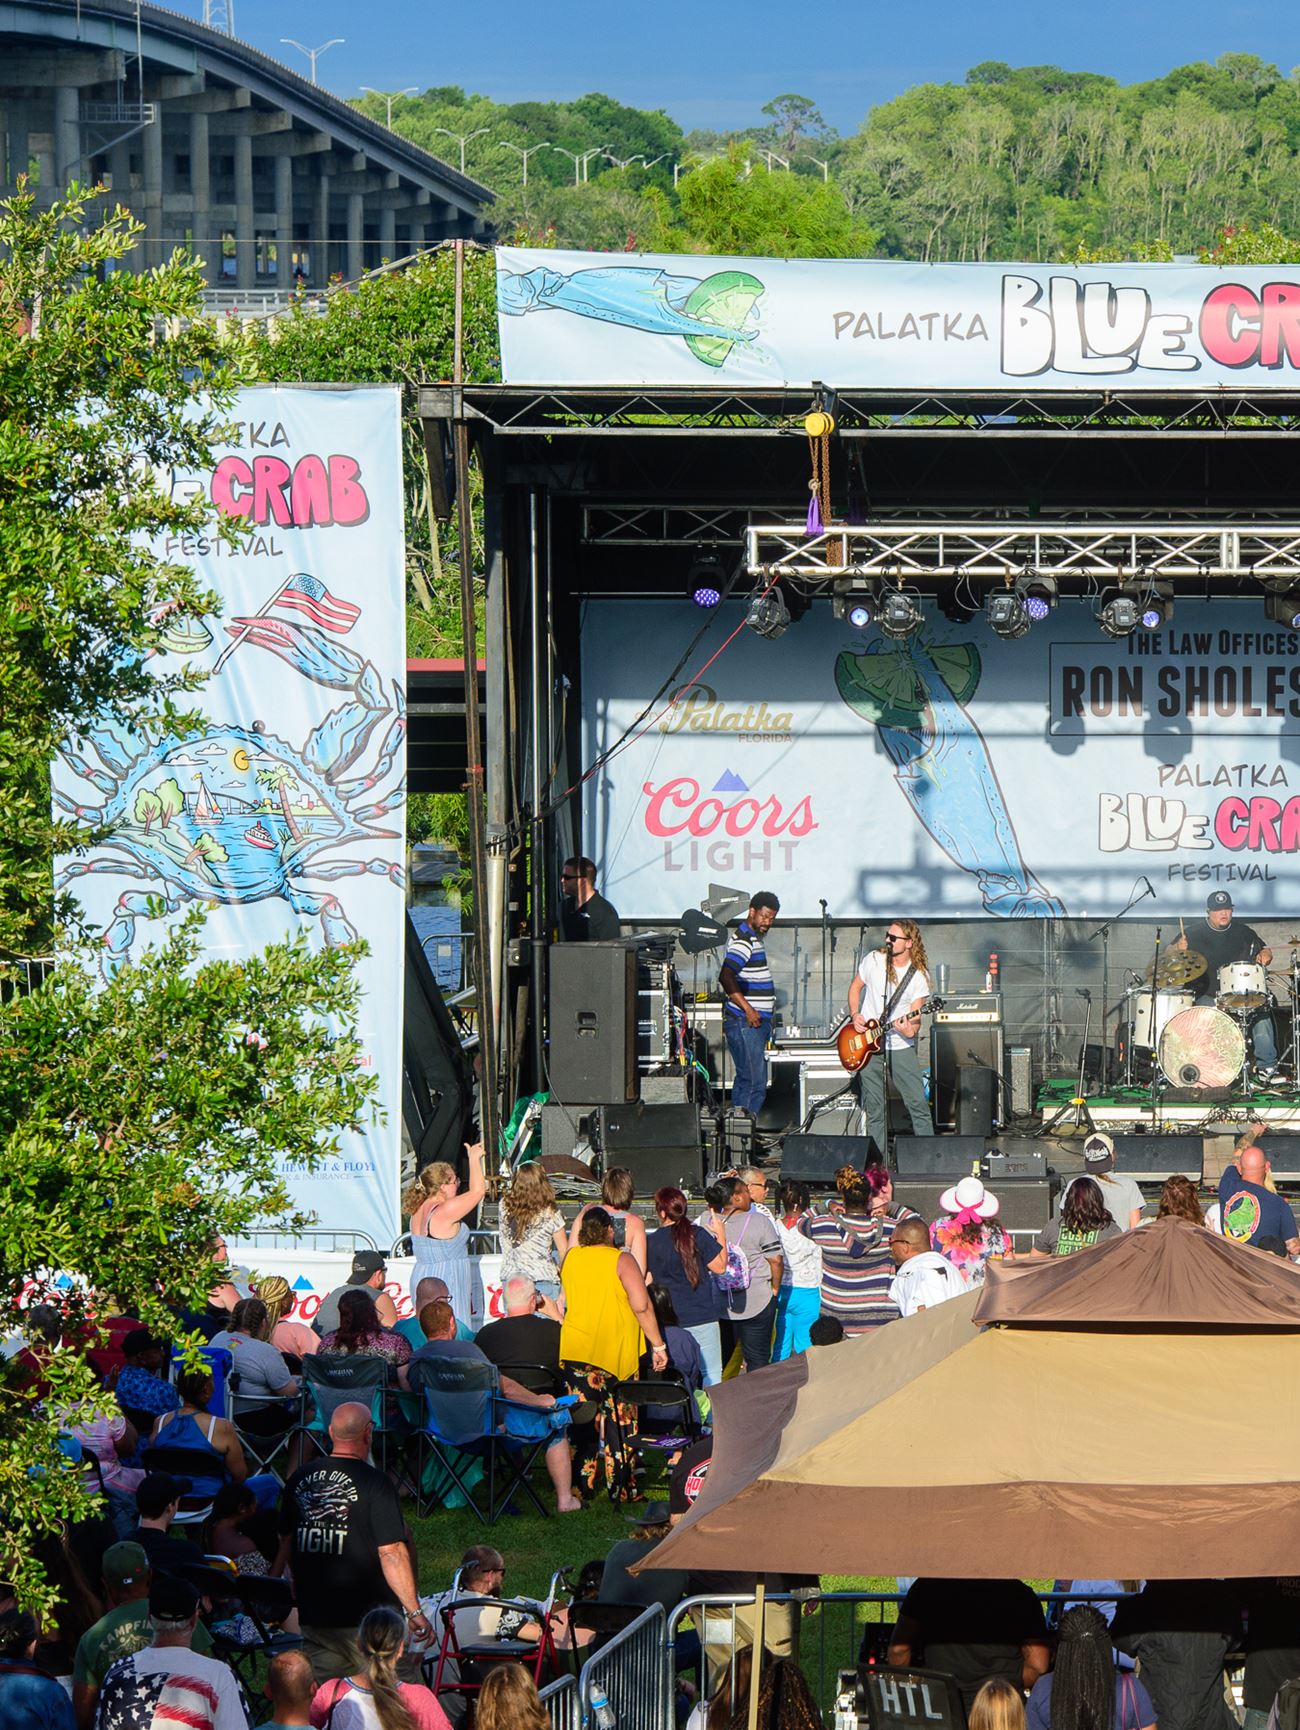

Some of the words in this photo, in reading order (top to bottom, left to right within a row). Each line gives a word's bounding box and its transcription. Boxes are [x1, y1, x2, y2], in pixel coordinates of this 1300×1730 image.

[832, 311, 989, 341] PALATKA
[1000, 274, 1202, 377] BLUE
[211, 454, 371, 529] CRAB
[659, 683, 794, 735] Palatka
[1062, 666, 1144, 718] RON
[738, 734, 793, 743] FLORIDA
[1157, 763, 1289, 788] PALATKA
[643, 777, 820, 837] Coors
[1099, 793, 1214, 852] BLUE
[664, 841, 801, 872] LIGHT
[1168, 863, 1277, 882] FESTIVAL
[295, 1470, 327, 1494] NEVER
[329, 1470, 352, 1486] GIVE
[346, 1486, 359, 1502] UP
[879, 1678, 943, 1719] HTL
